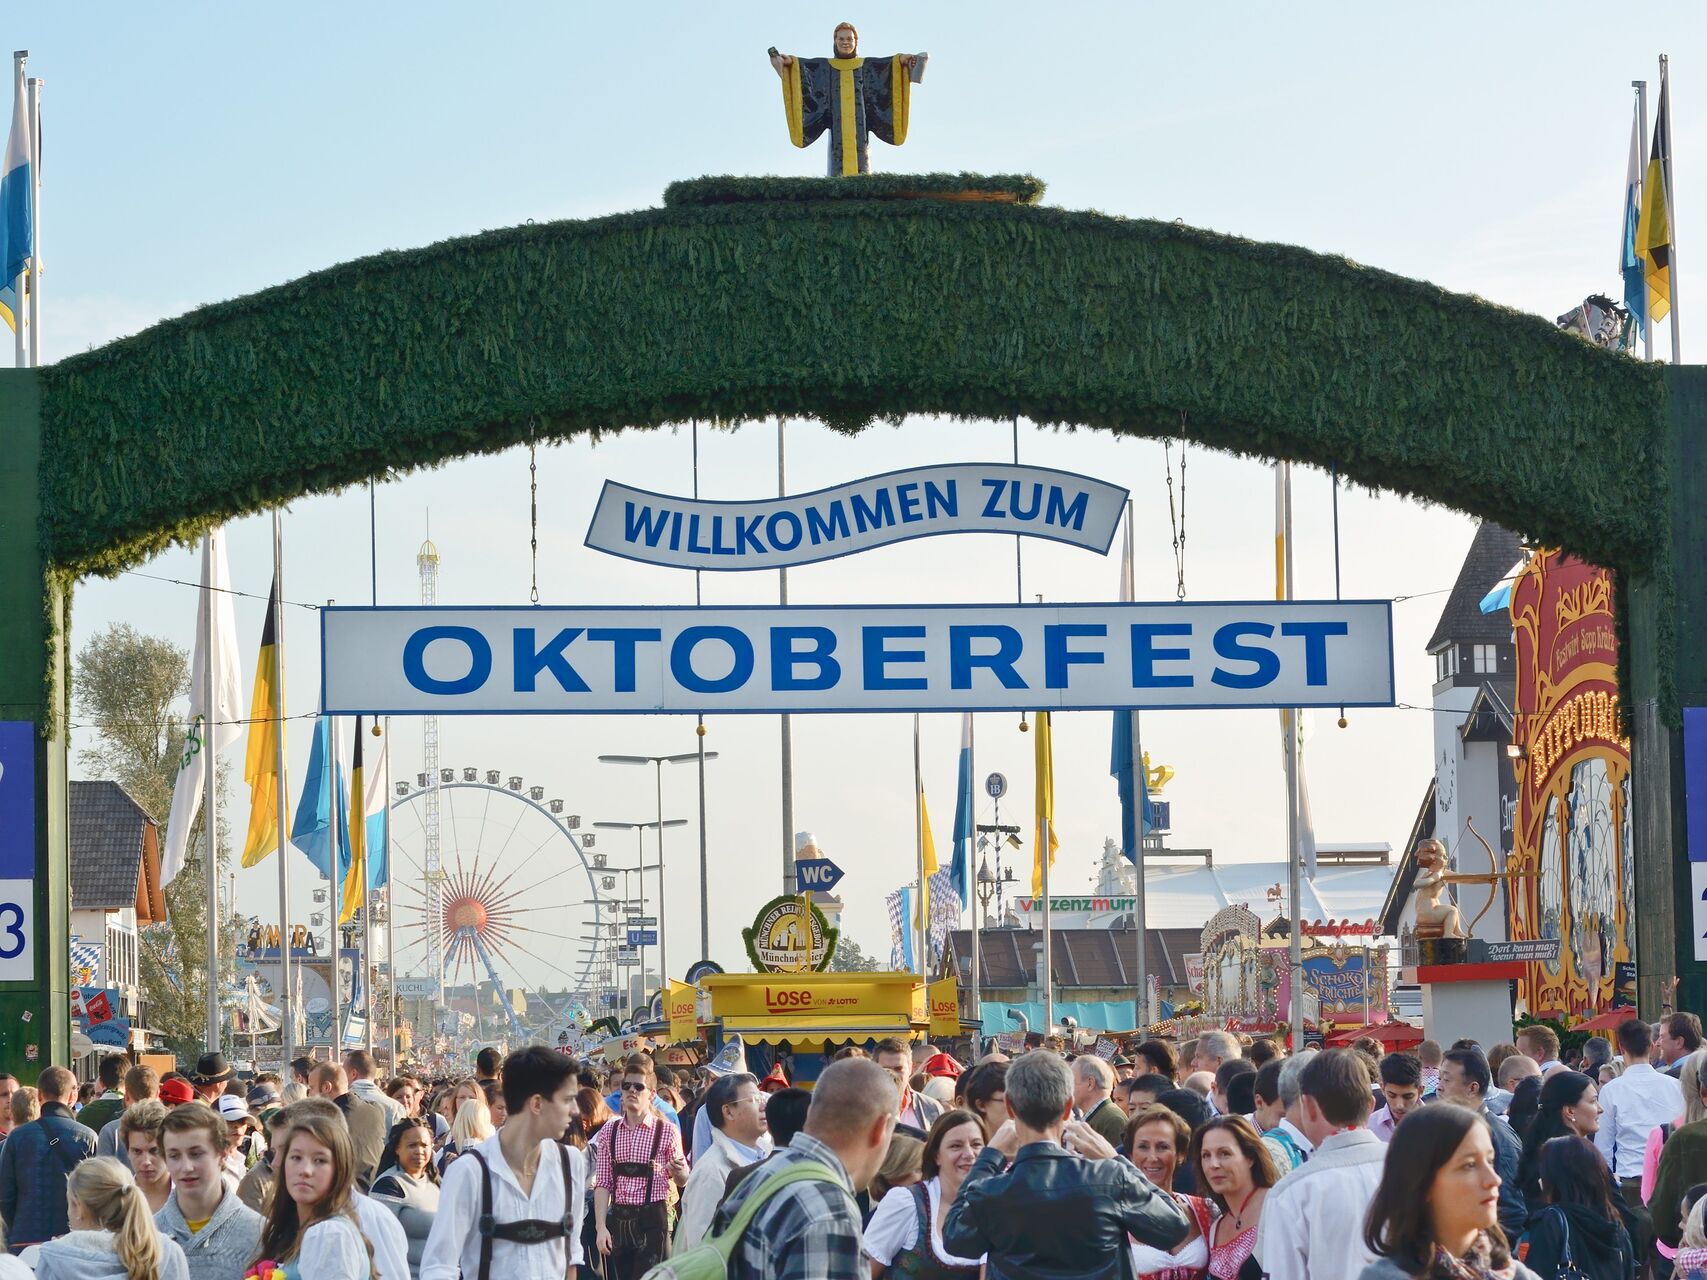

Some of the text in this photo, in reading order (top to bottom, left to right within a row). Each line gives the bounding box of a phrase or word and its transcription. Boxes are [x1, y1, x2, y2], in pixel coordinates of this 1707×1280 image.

[622, 478, 1089, 555] WILLKOMMEN ZUM
[1581, 628, 1597, 654] Sepp
[402, 620, 1349, 696] OKTOBERFEST
[1532, 690, 1630, 788] HIPPODRO
[801, 864, 834, 883] WC
[631, 931, 640, 943] U
[1488, 944, 1512, 955] Dort
[1512, 943, 1535, 953] kann
[1490, 952, 1514, 961] wenn
[1515, 951, 1534, 960] man
[766, 986, 812, 1006] Lose
[671, 1002, 694, 1014] Lose
[931, 998, 956, 1012] Lose
[623, 1040, 638, 1050] Eis
[668, 1051, 684, 1062] Eis
